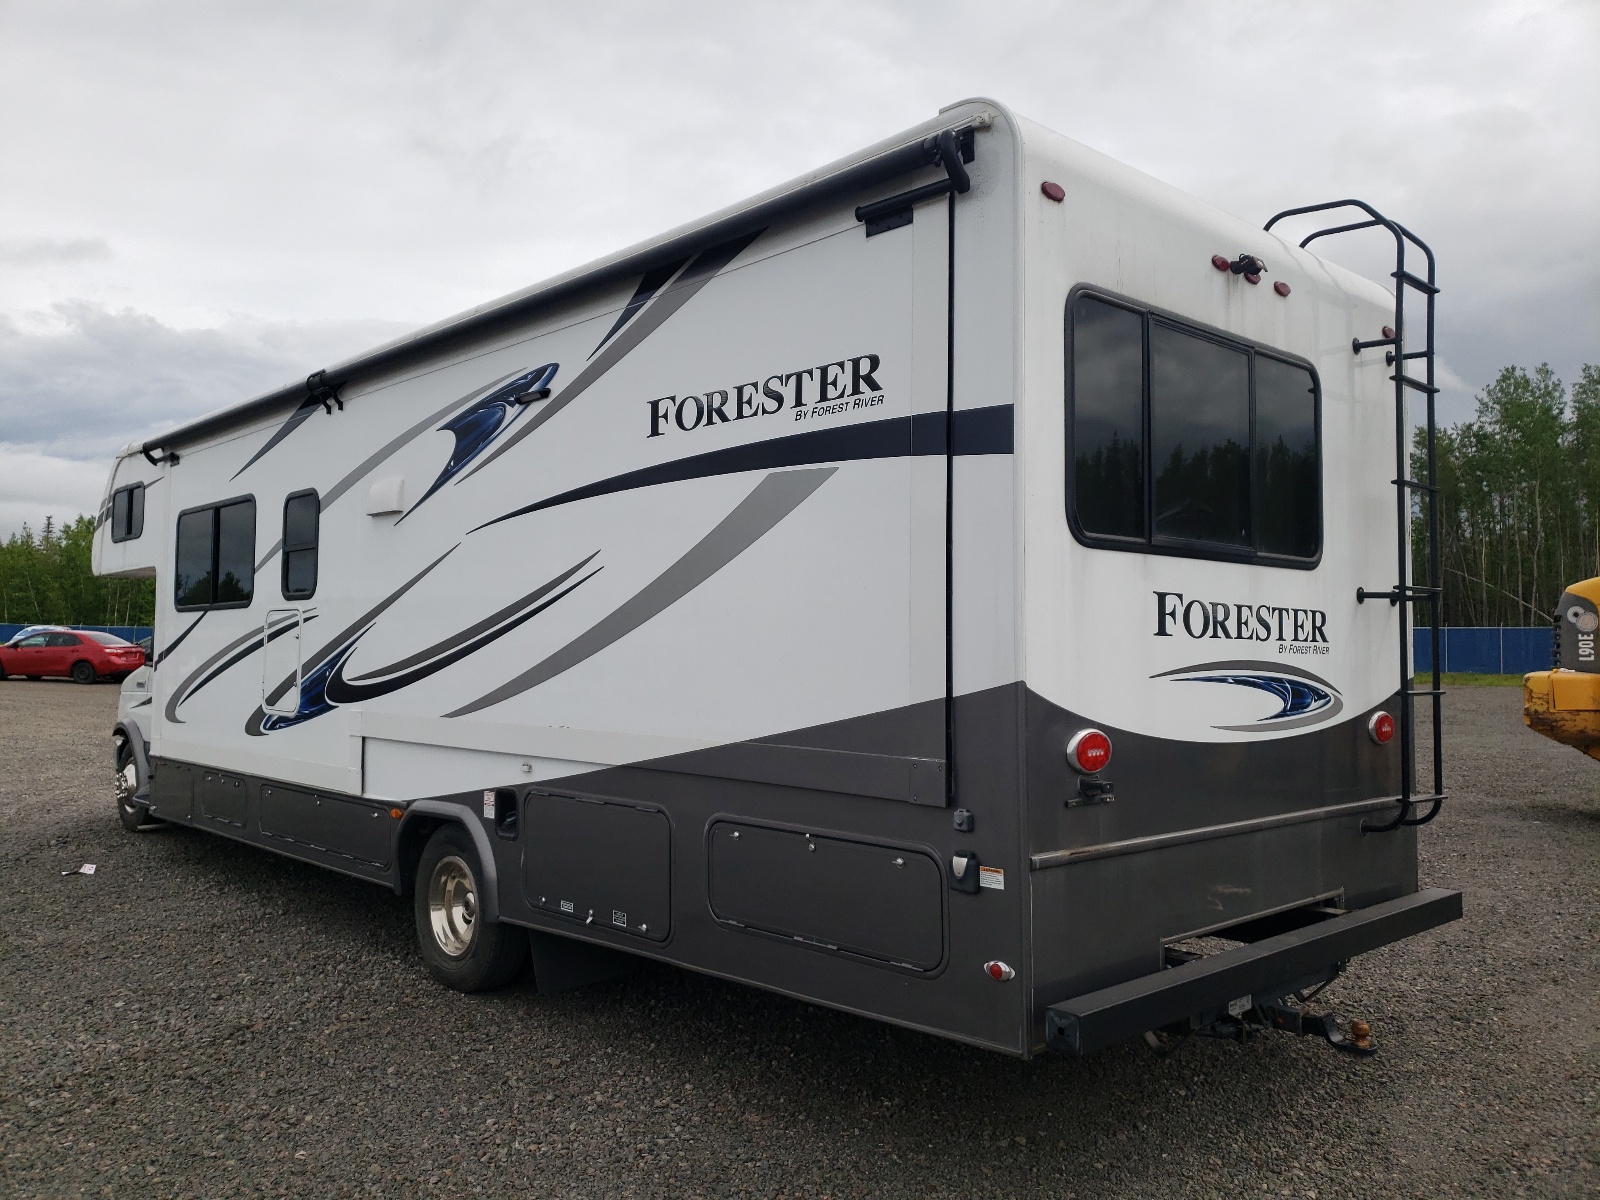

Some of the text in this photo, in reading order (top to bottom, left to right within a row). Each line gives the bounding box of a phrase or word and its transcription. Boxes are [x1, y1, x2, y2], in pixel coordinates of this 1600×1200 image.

[646, 353, 884, 439] FORESTER
[794, 394, 885, 422] BY FOREST RIVER
[1152, 590, 1330, 643] FORESTER
[1278, 643, 1330, 655] BY FOREST RIVER
[1578, 633, 1595, 661] L90E
